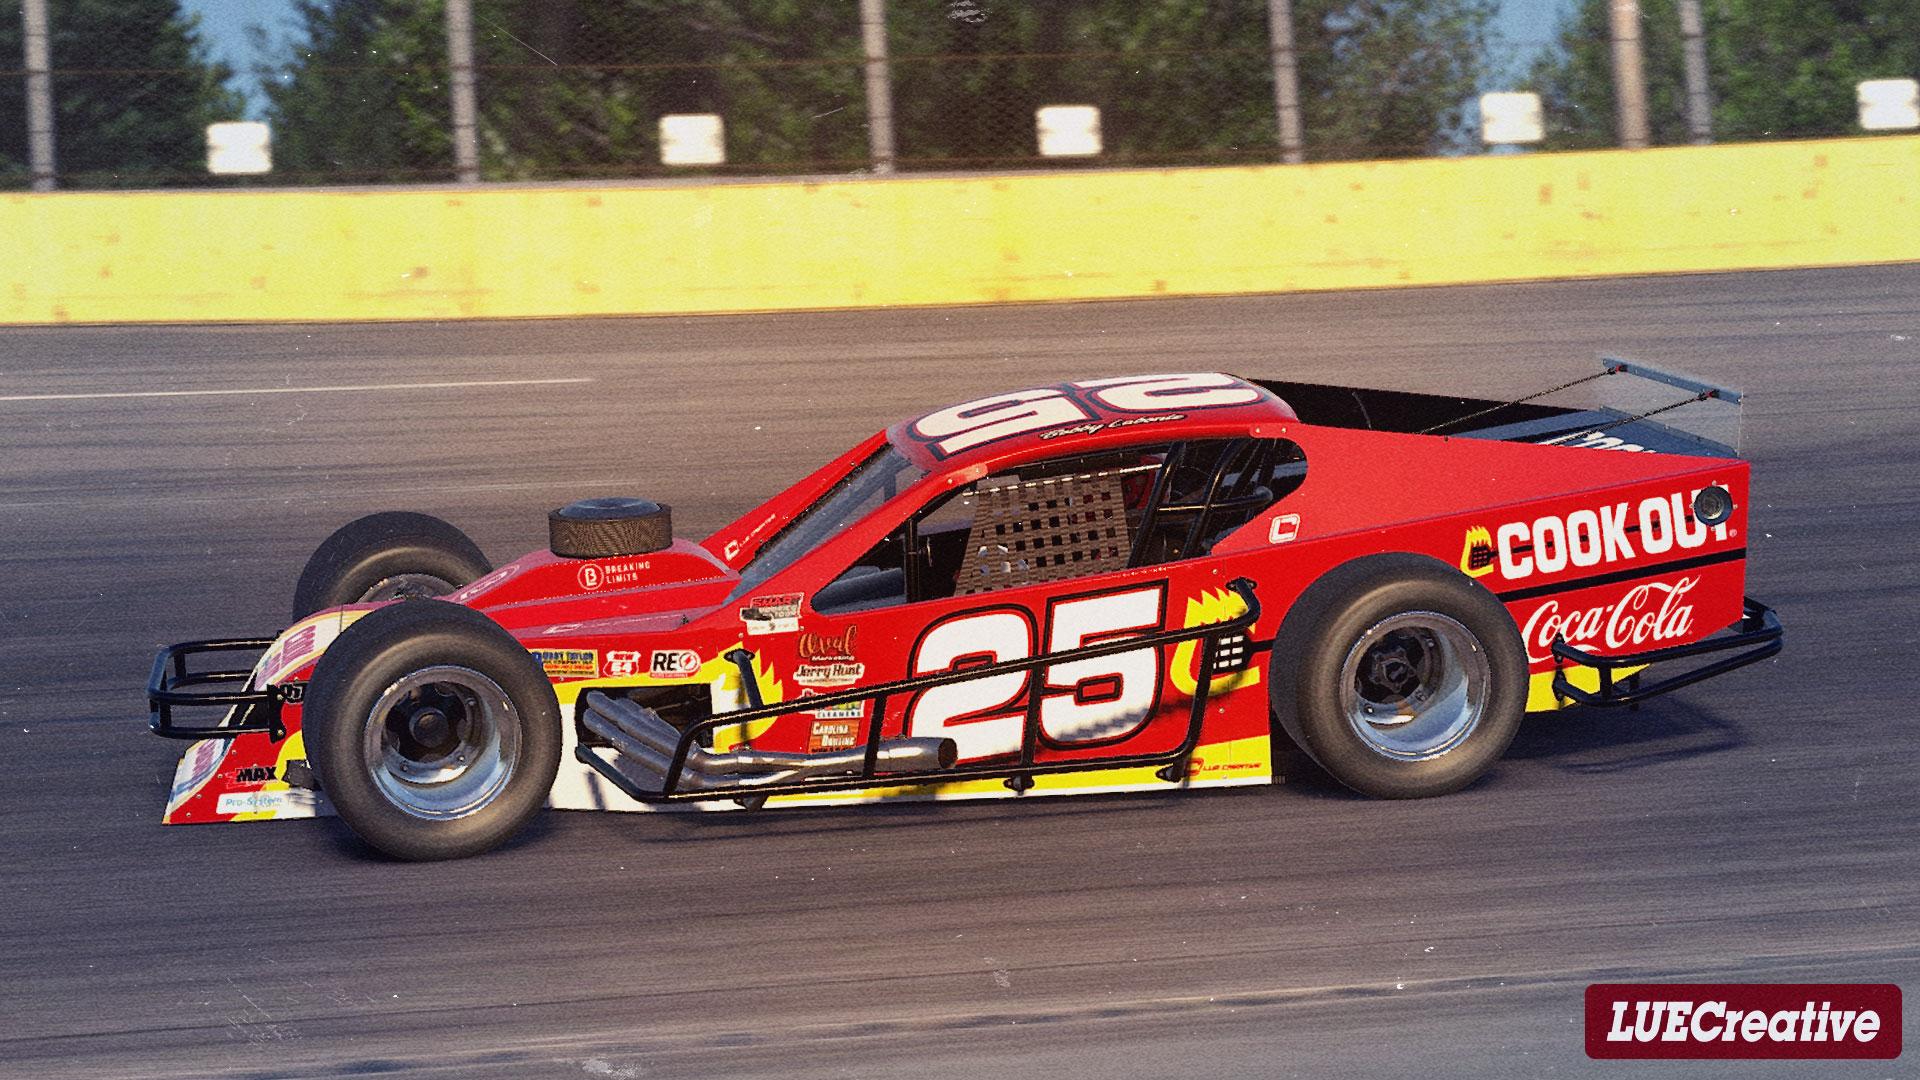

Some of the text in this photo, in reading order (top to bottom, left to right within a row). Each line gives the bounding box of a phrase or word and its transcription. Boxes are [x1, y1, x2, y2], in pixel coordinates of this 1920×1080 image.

[1497, 501, 1636, 580] COOK
[605, 561, 650, 574] BREAKING
[606, 572, 638, 583] LIMITS
[1522, 575, 1701, 663] Coca-Cola
[799, 625, 857, 658] Oval
[797, 664, 862, 678] Jerry Hunt
[908, 584, 1165, 765] 25
[813, 721, 849, 735] CAROLINA
[236, 766, 277, 782] MAX
